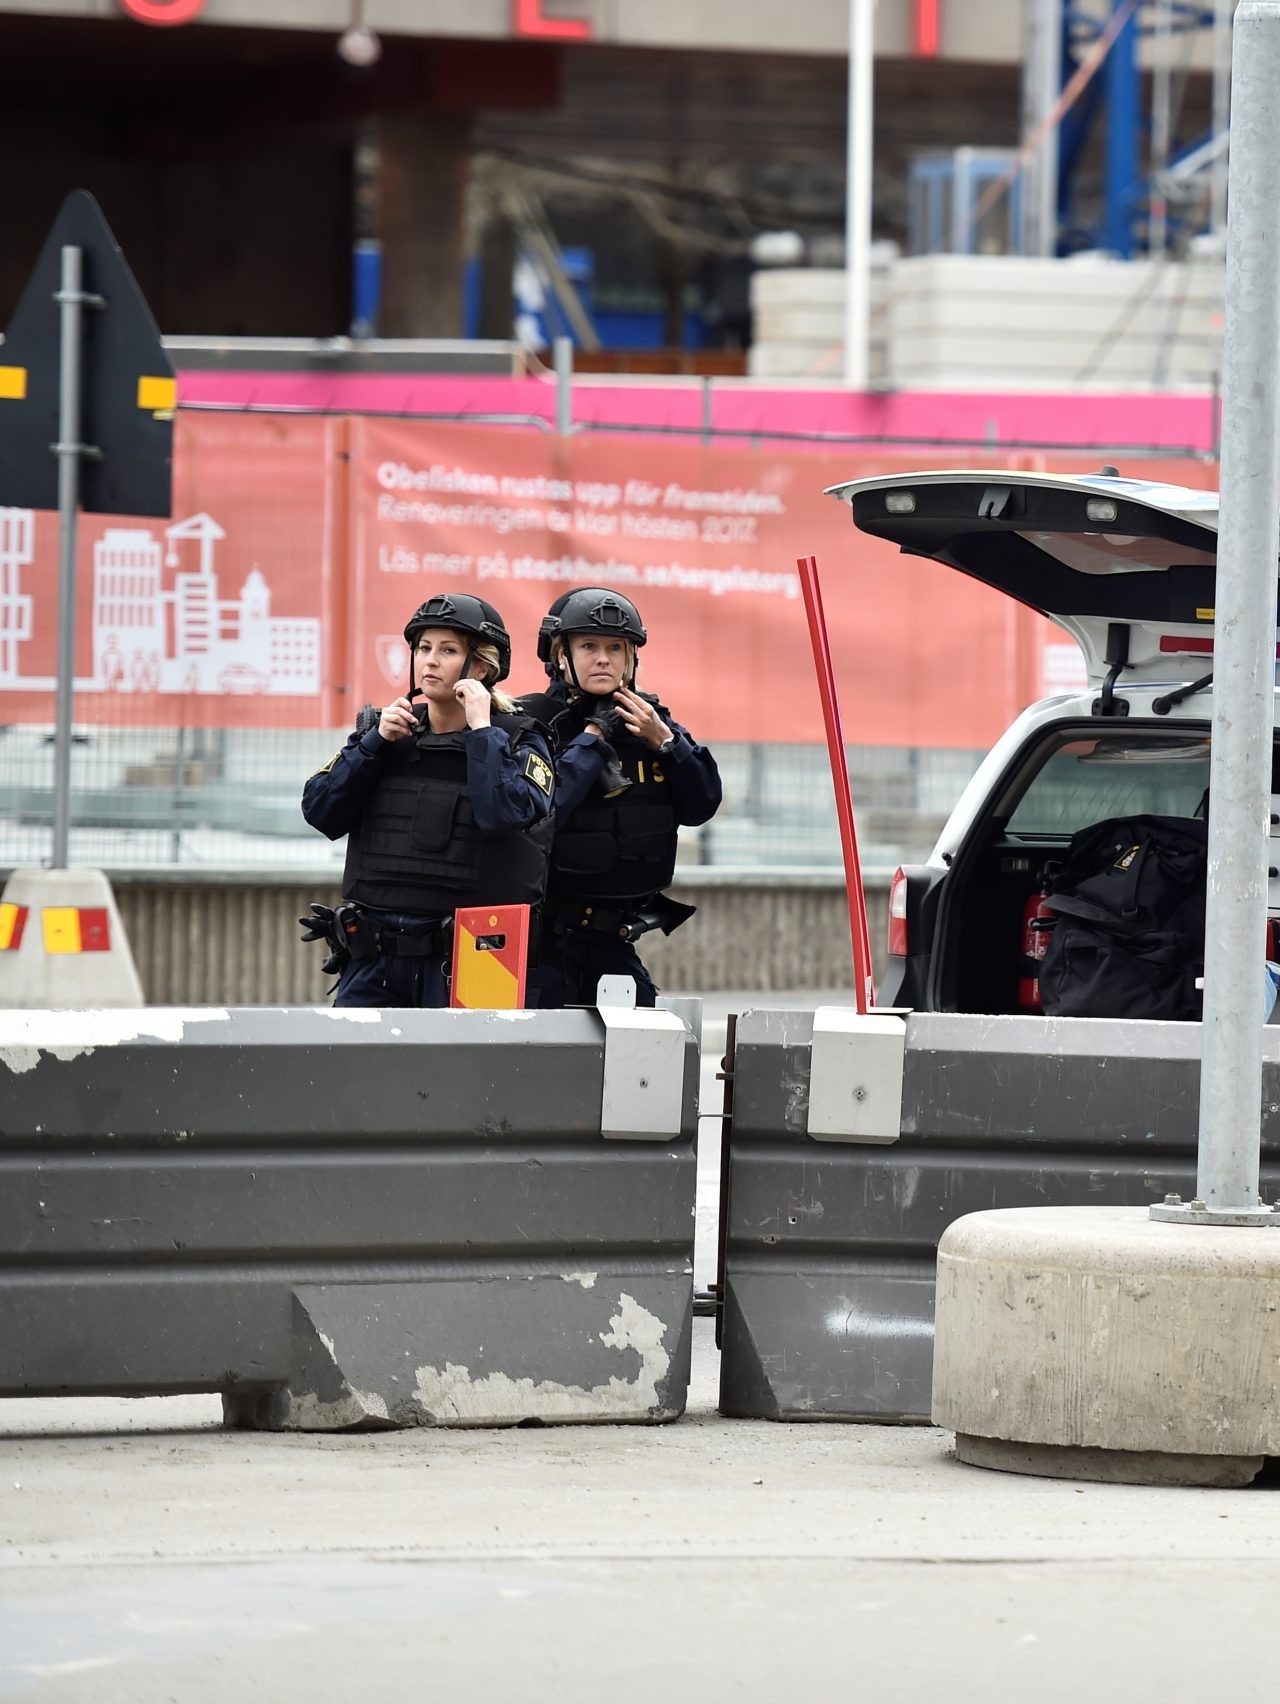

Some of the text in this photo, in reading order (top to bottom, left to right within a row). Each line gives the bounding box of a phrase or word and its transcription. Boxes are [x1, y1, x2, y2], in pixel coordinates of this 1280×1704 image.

[377, 461, 499, 495] Obelisken
[575, 481, 621, 509] upp
[624, 480, 661, 507] för
[377, 493, 545, 534] Renoveringen
[574, 507, 617, 537] klar
[379, 543, 419, 574] Läs
[422, 551, 473, 576] mer
[476, 548, 510, 582] på
